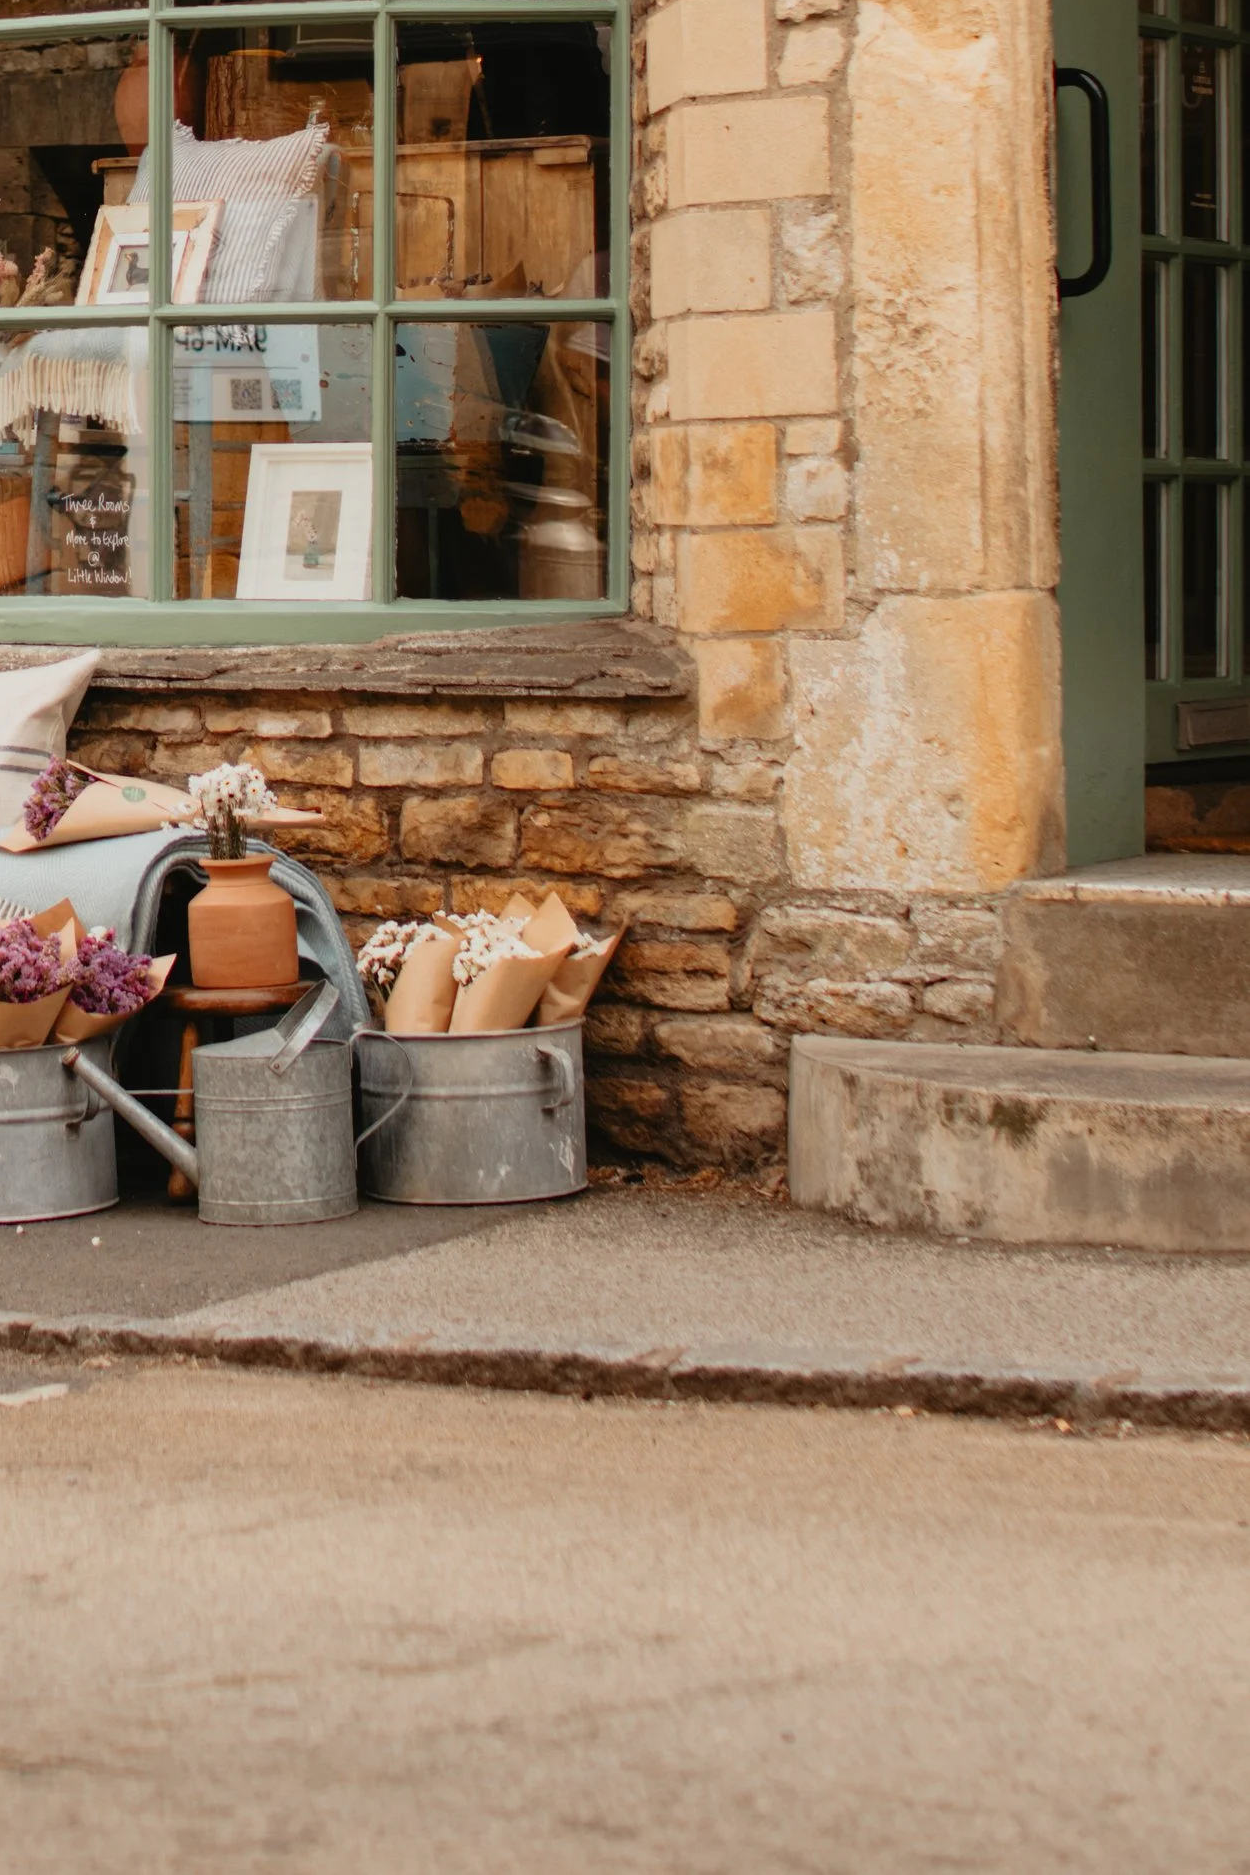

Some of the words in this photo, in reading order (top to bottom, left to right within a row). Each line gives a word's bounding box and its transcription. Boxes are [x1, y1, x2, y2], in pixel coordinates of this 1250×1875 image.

[61, 493, 97, 514] Three
[97, 492, 130, 514] Rooms
[66, 529, 89, 548] More
[90, 531, 101, 545] to
[102, 531, 131, 552] Explore
[87, 551, 100, 566] @
[67, 568, 92, 584] Little
[94, 566, 132, 585] Window!
